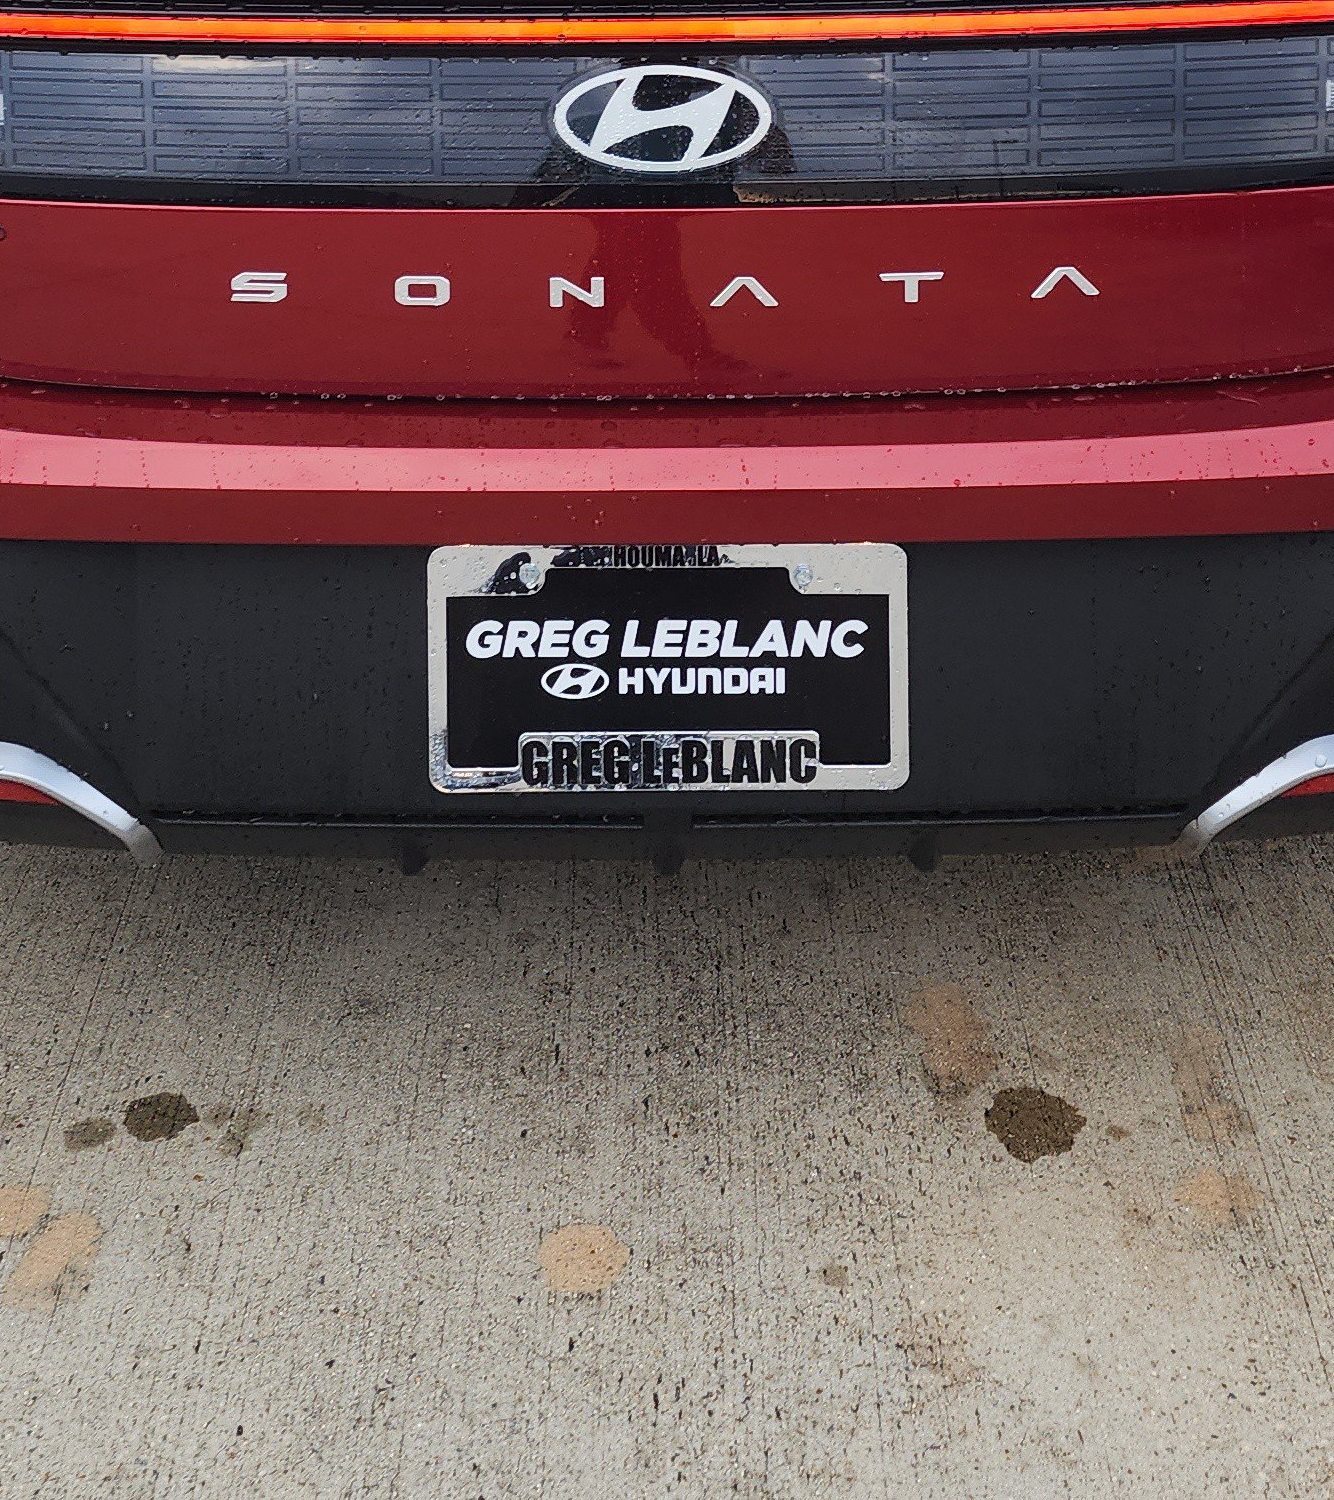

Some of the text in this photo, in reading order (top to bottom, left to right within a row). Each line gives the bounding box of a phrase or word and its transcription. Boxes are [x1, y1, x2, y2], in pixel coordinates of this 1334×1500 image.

[229, 265, 1101, 308] SONATA
[465, 619, 869, 659] GREG LEBLANC
[618, 666, 787, 695] HYUNDAI
[521, 739, 632, 787] GREG
